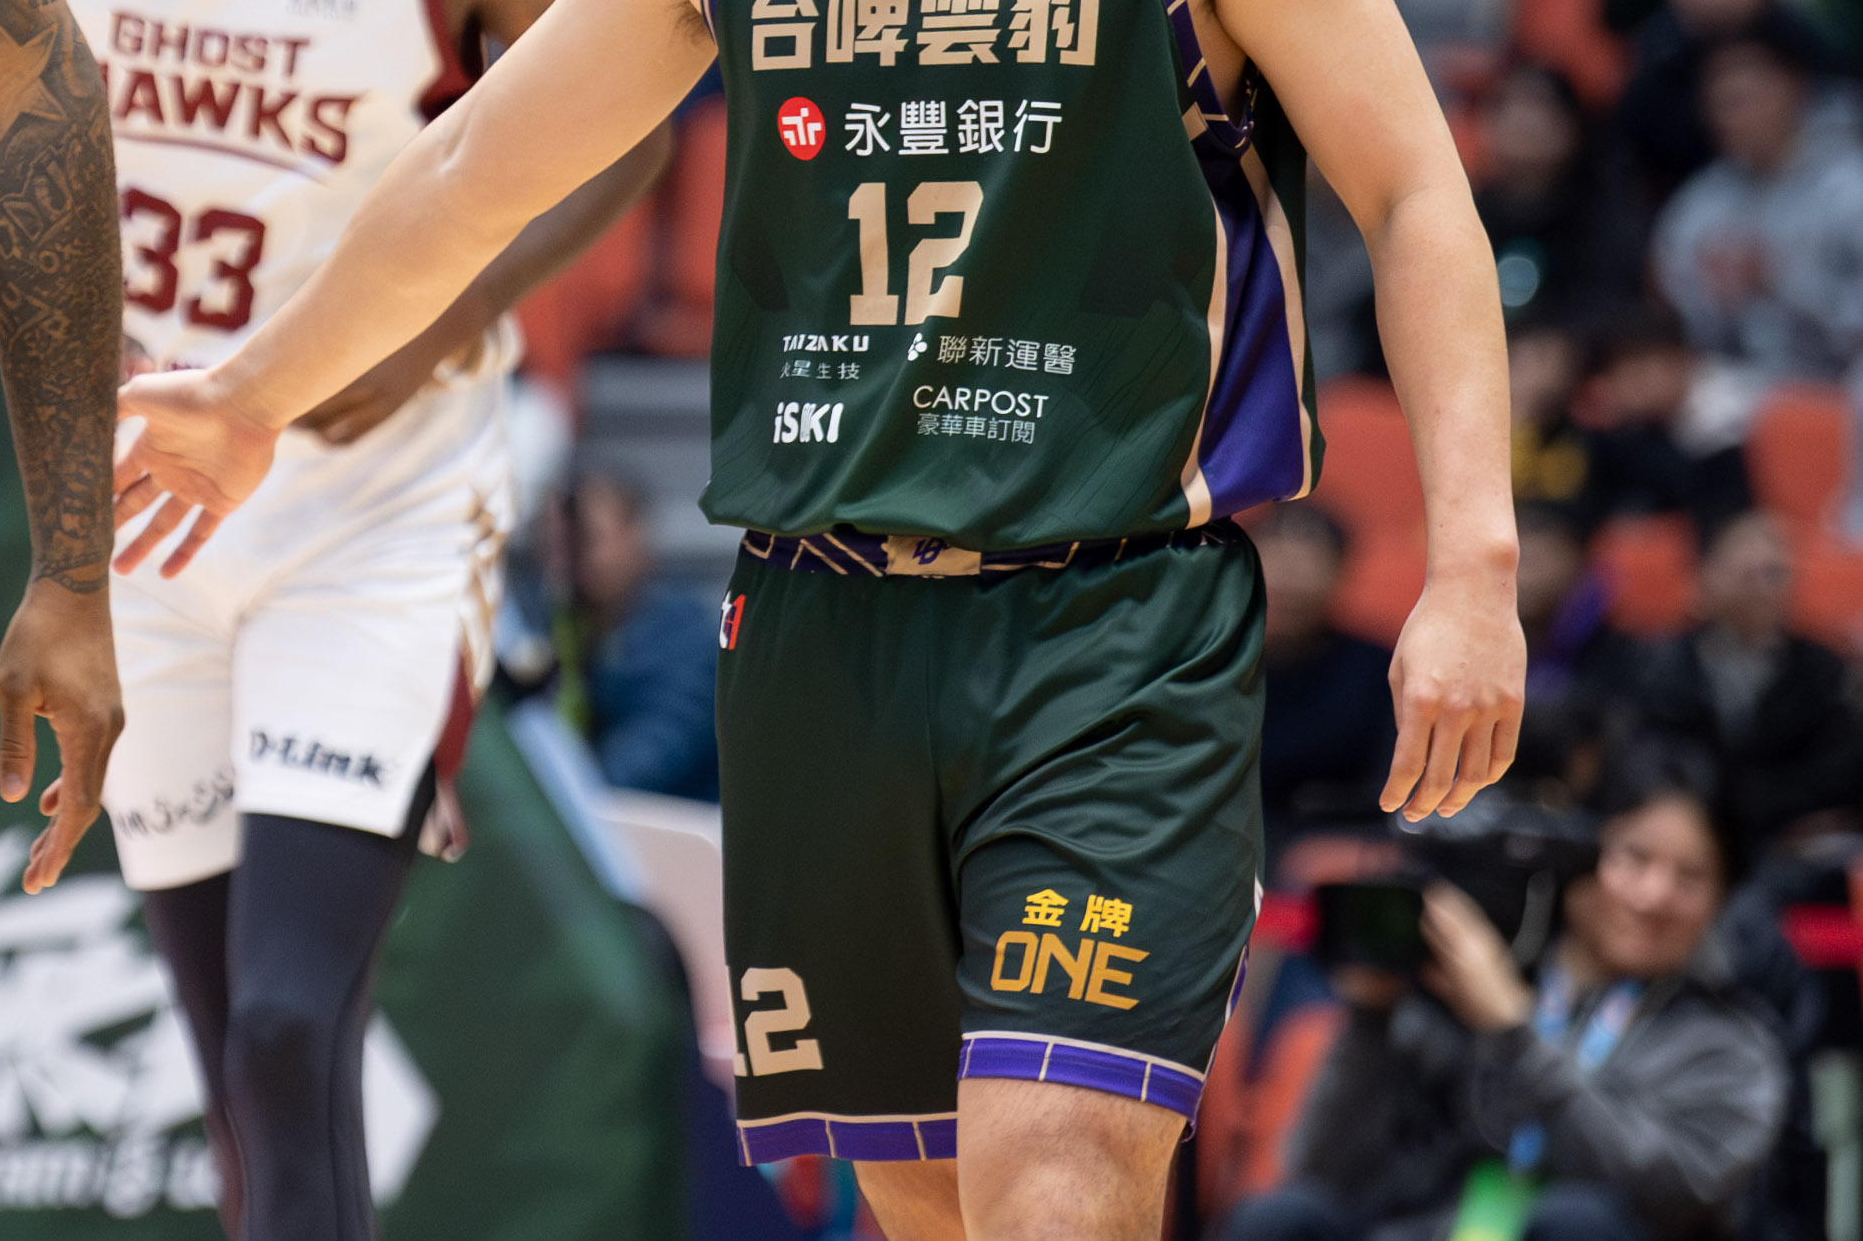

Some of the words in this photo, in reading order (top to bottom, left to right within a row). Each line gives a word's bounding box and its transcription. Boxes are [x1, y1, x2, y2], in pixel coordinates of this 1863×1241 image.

[111, 9, 311, 77] GHOST
[98, 59, 359, 164] AWKS
[844, 100, 1063, 155] 永豐銀行
[122, 188, 265, 332] 33
[848, 181, 984, 325] 12
[780, 360, 861, 380] 火星生技
[783, 334, 870, 352] TAIZAKU
[937, 335, 1077, 375] 聯新運醫
[773, 401, 844, 444] iSKI
[913, 385, 1050, 418] CARPOST
[917, 413, 1036, 445] 豪華車訂閱
[249, 728, 384, 787] D-Link
[1021, 889, 1133, 938] 金牌
[990, 930, 1151, 1011] ONE
[732, 967, 824, 1078] 2
